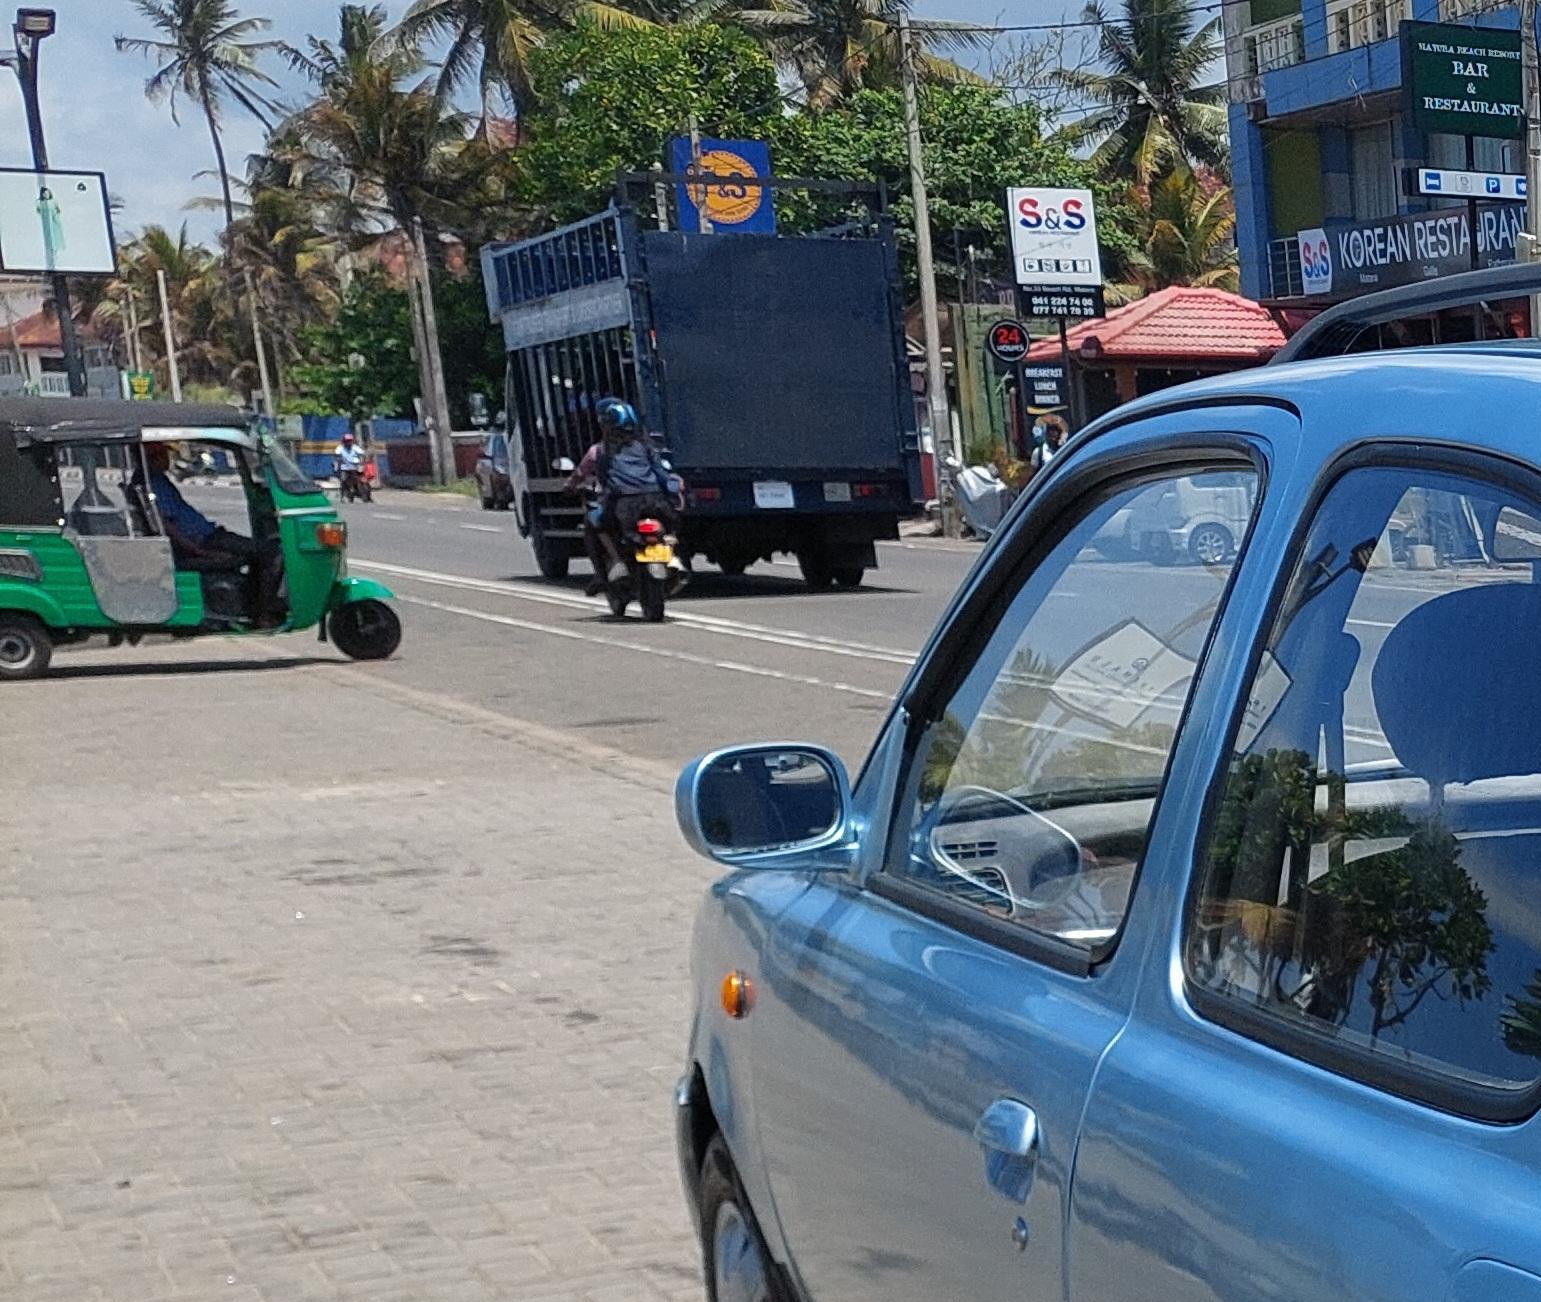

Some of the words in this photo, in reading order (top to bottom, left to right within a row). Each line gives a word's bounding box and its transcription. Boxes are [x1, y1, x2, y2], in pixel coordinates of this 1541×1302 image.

[1457, 46, 1486, 56] BEACH
[1452, 61, 1489, 77] BAR
[1467, 82, 1476, 94] &
[1423, 97, 1521, 116] RESTAURANT
[1018, 198, 1086, 230] S&S
[1338, 222, 1411, 270] KOREAN
[1414, 206, 1527, 260] RESTAURAN
[996, 328, 1020, 345] 24
